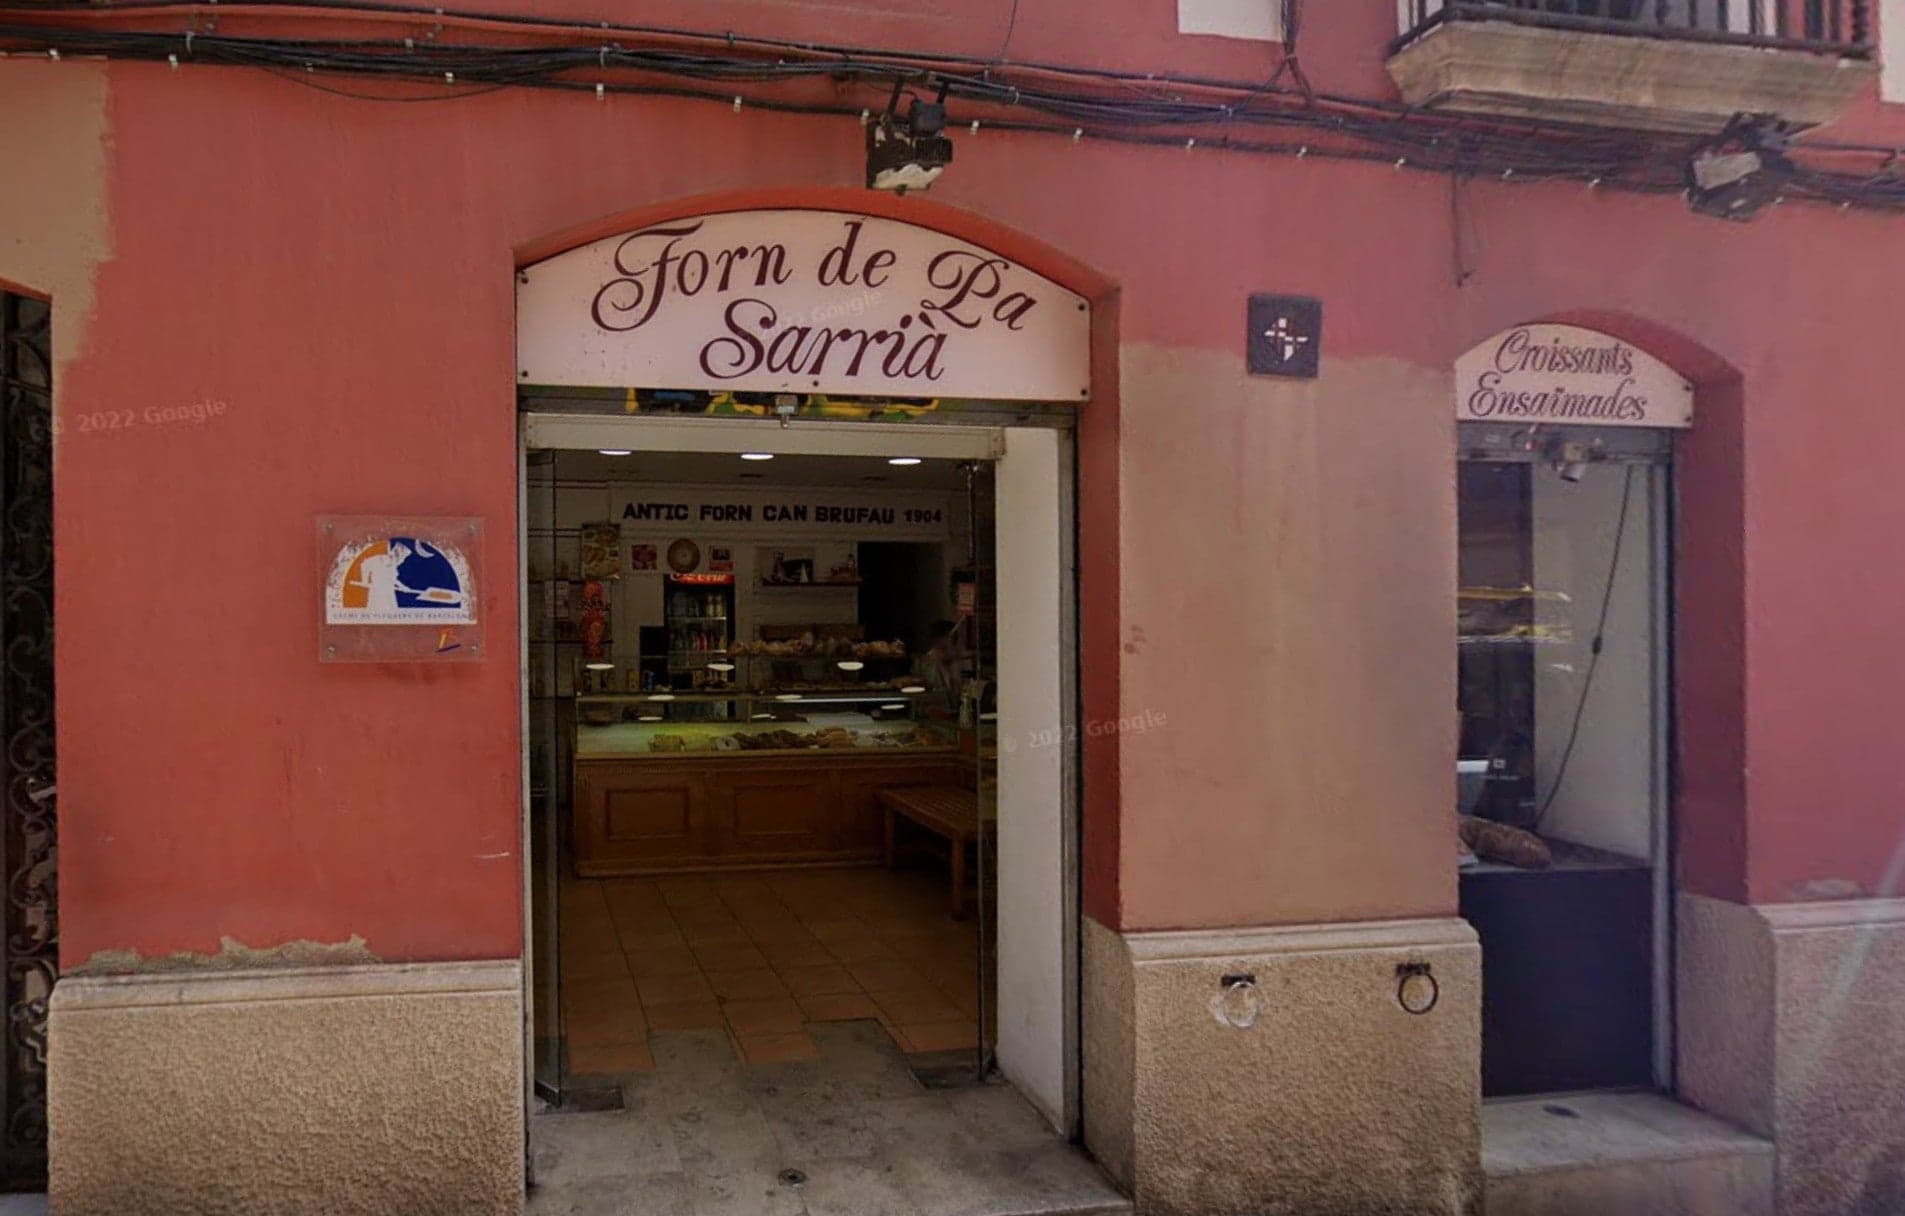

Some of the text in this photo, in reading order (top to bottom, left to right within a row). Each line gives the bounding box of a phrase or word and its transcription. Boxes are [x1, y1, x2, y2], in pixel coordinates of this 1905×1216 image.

[591, 219, 1038, 332] Forn de Pa
[699, 298, 949, 381] Sarrià
[1495, 330, 1633, 376] Croissants
[1468, 371, 1648, 421] Ensaïmades
[622, 501, 943, 525] ANTIC FORN CAN BRUFAU 1904
